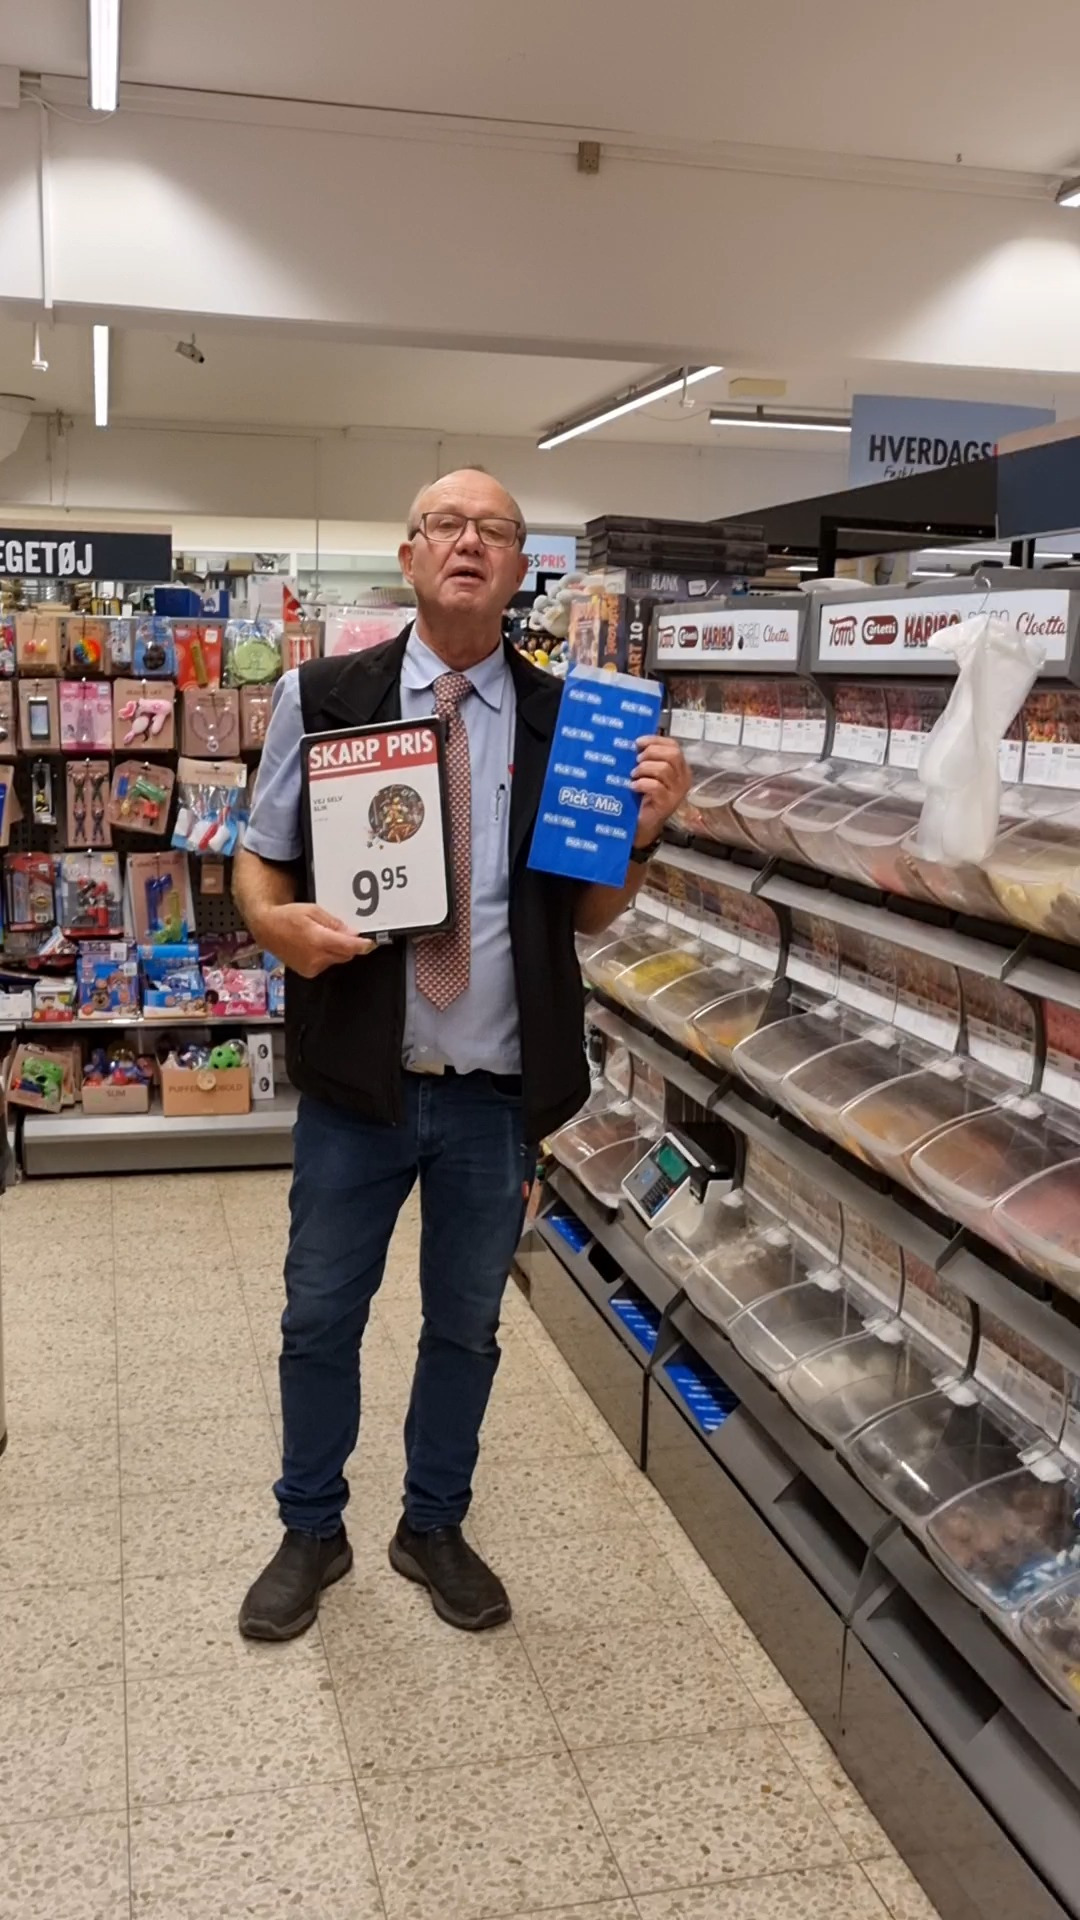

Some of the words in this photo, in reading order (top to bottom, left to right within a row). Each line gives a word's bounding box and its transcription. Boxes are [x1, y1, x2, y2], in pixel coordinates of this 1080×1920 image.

[869, 433, 999, 466] HVERDAGS
[629, 621, 644, 641] 10
[702, 624, 735, 651] HARIBO
[829, 615, 858, 647] Toms
[1016, 611, 1067, 636] Cloetta
[627, 643, 643, 677] ART
[309, 737, 379, 769] SKARP
[387, 729, 433, 759] PRIS
[560, 788, 588, 806] Pick
[595, 797, 620, 812] Mix
[352, 869, 379, 917] 9
[380, 865, 408, 891] 95
